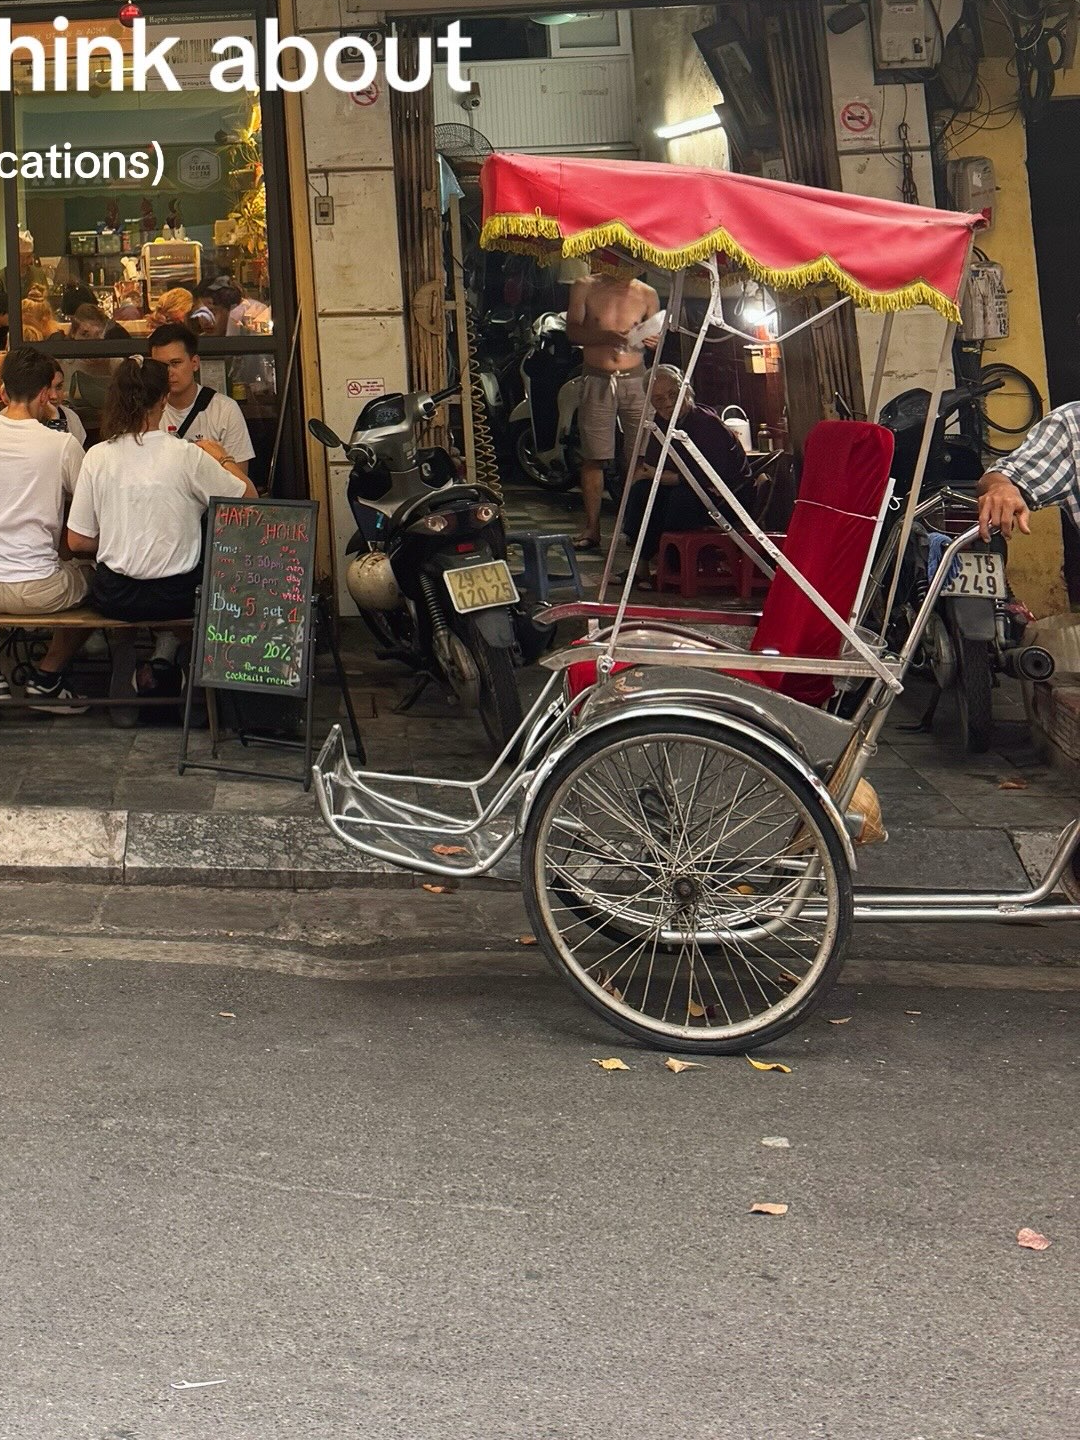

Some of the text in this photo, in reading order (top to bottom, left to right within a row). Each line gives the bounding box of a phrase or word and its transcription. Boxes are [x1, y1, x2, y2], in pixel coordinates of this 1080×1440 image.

[212, 592, 240, 618] Buy
[245, 597, 255, 616] 5
[207, 625, 235, 644] Sale
[263, 643, 291, 661] 20%
